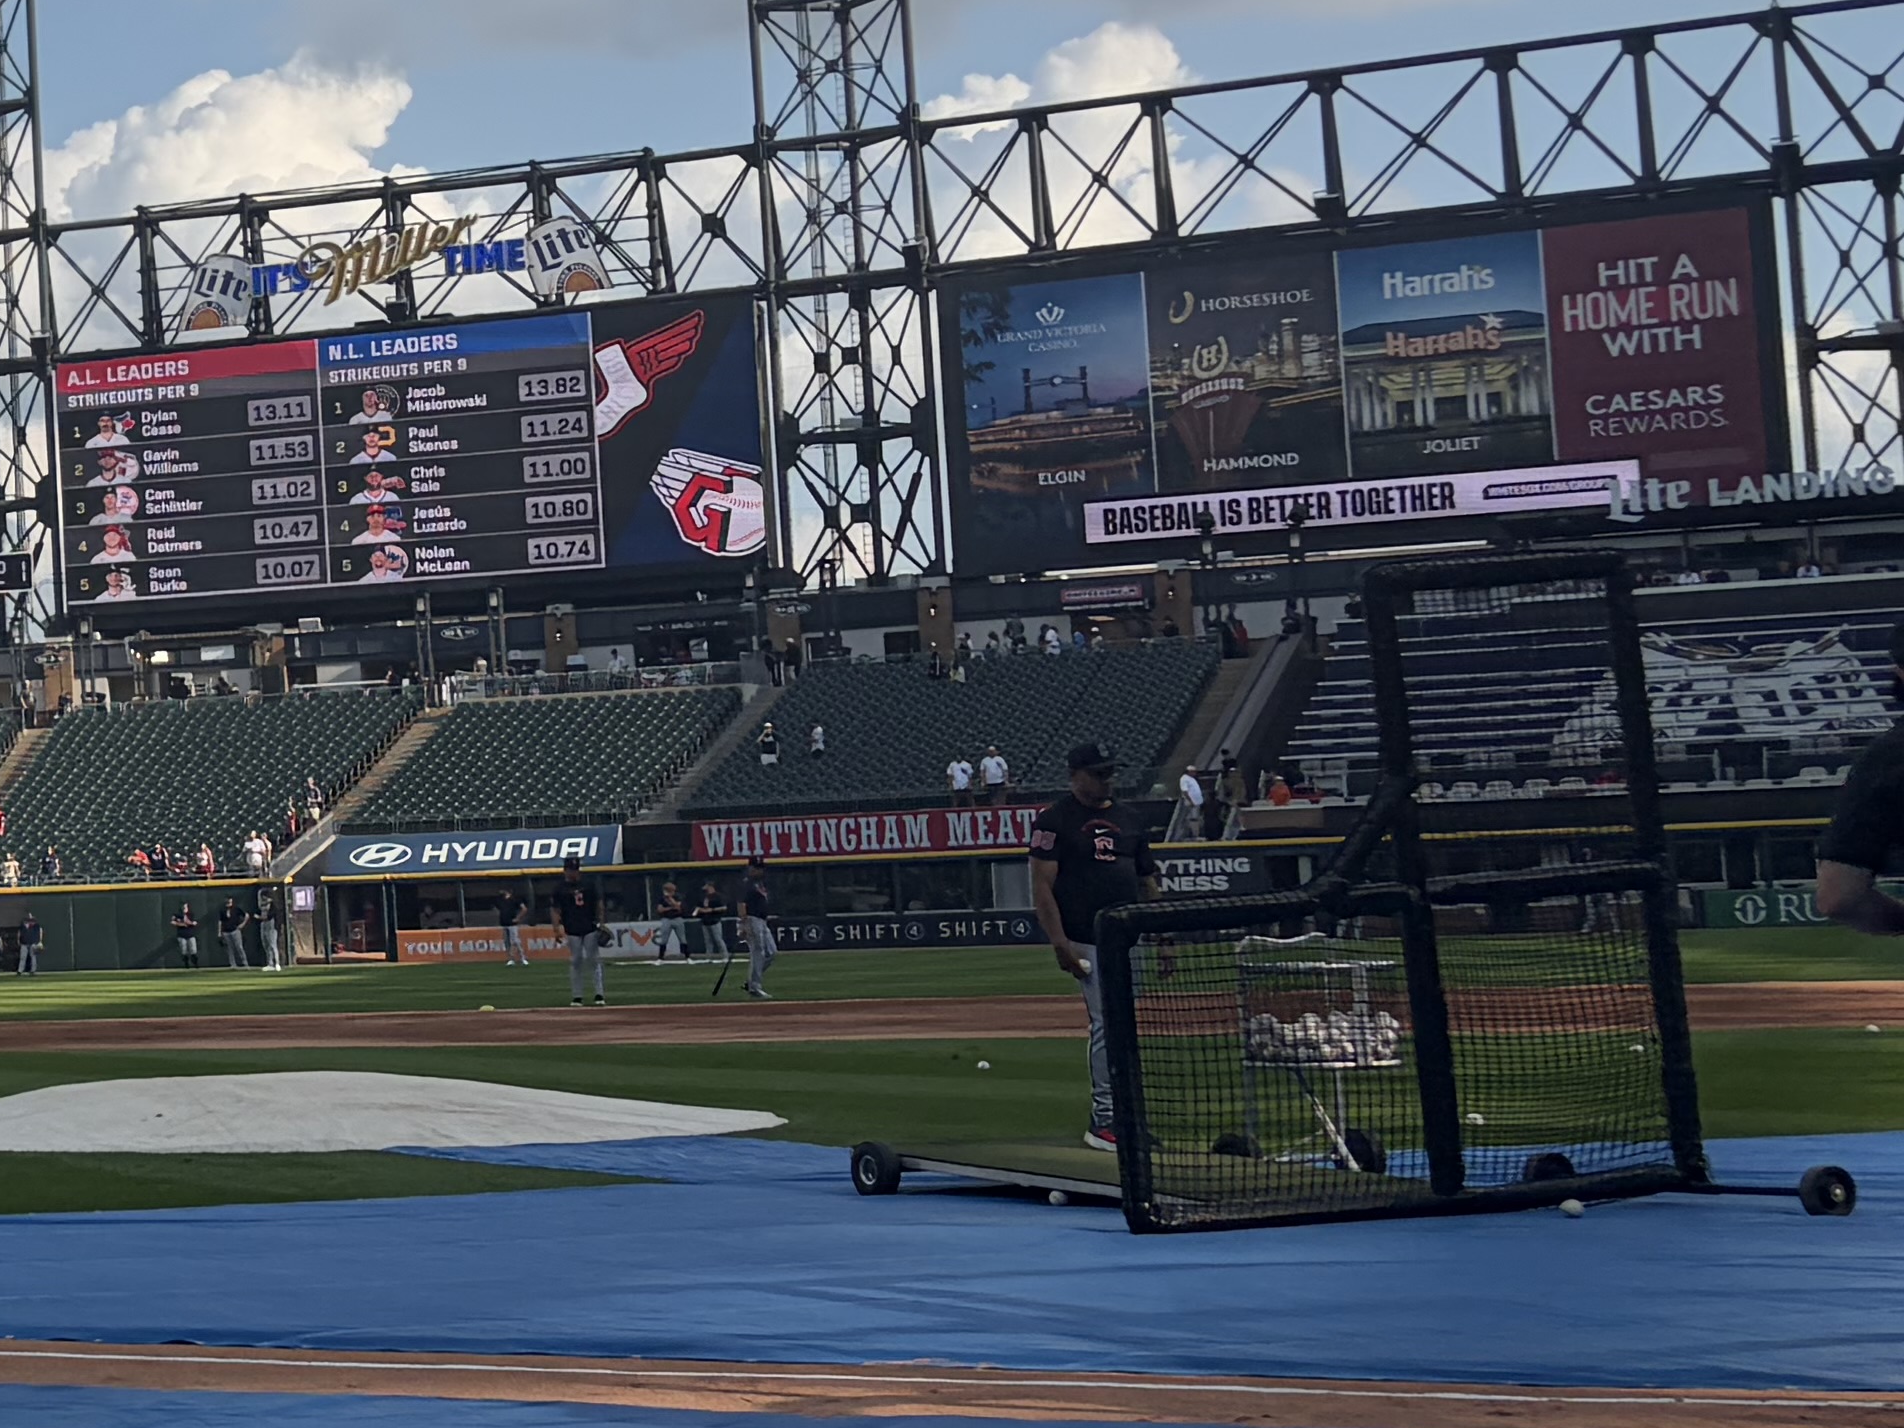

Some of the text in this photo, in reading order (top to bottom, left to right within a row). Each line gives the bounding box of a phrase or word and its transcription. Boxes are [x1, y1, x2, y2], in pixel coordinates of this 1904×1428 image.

[297, 212, 479, 307] Miller
[442, 239, 526, 276] TIME
[532, 227, 589, 272] Lite
[1597, 253, 1700, 287] HIT A
[194, 267, 249, 302] Lite
[1201, 289, 1314, 312] HORSESHOE
[1562, 277, 1740, 332] HOME RUN
[329, 333, 457, 361] N.L. LEADERS
[1602, 324, 1702, 357] WITH
[67, 360, 189, 387] A.L. LEADERS
[329, 358, 467, 383] STRIKEOUTS PER 9
[68, 384, 199, 407] STRIKEOUTS PER 9
[406, 384, 445, 398] Jacob
[524, 376, 581, 396] 13.82
[1586, 384, 1725, 415] CAESARS
[142, 410, 177, 424] Dylan
[253, 402, 307, 422] 13.11
[409, 426, 438, 439] Paul
[527, 417, 584, 437] 11.24
[1589, 408, 1729, 437] REWARDS
[255, 442, 309, 461] 11.53
[1422, 436, 1481, 454] JOLIET
[143, 449, 179, 462] Gavin
[1203, 452, 1299, 472] HAMMOND
[144, 461, 199, 476] Williams
[411, 466, 445, 479] Chris
[529, 458, 586, 478] 11.00
[1038, 470, 1086, 486] ELGIN
[145, 489, 175, 500] Cam
[257, 482, 311, 501] 11.02
[1606, 477, 1691, 522] Lite
[1708, 466, 1895, 506] LANDING
[531, 499, 588, 519] 10.80
[1220, 499, 1240, 527] IS
[1336, 482, 1456, 518] TOGETHER
[259, 521, 313, 540] 10.47
[413, 519, 467, 533] Luzardo
[415, 545, 454, 559] Nolan
[533, 541, 590, 560] 10.74
[261, 561, 314, 580] 10.07
[416, 559, 470, 573] McLean
[701, 807, 1045, 858] WHITTINGHAM MEAT
[422, 837, 599, 863] HYUNDAI
[1155, 857, 1251, 874] YTHING
[1158, 876, 1229, 892] NESS
[834, 923, 900, 941] SHIFT
[939, 921, 1007, 937] SHIFT
[405, 941, 453, 955] YOUR
